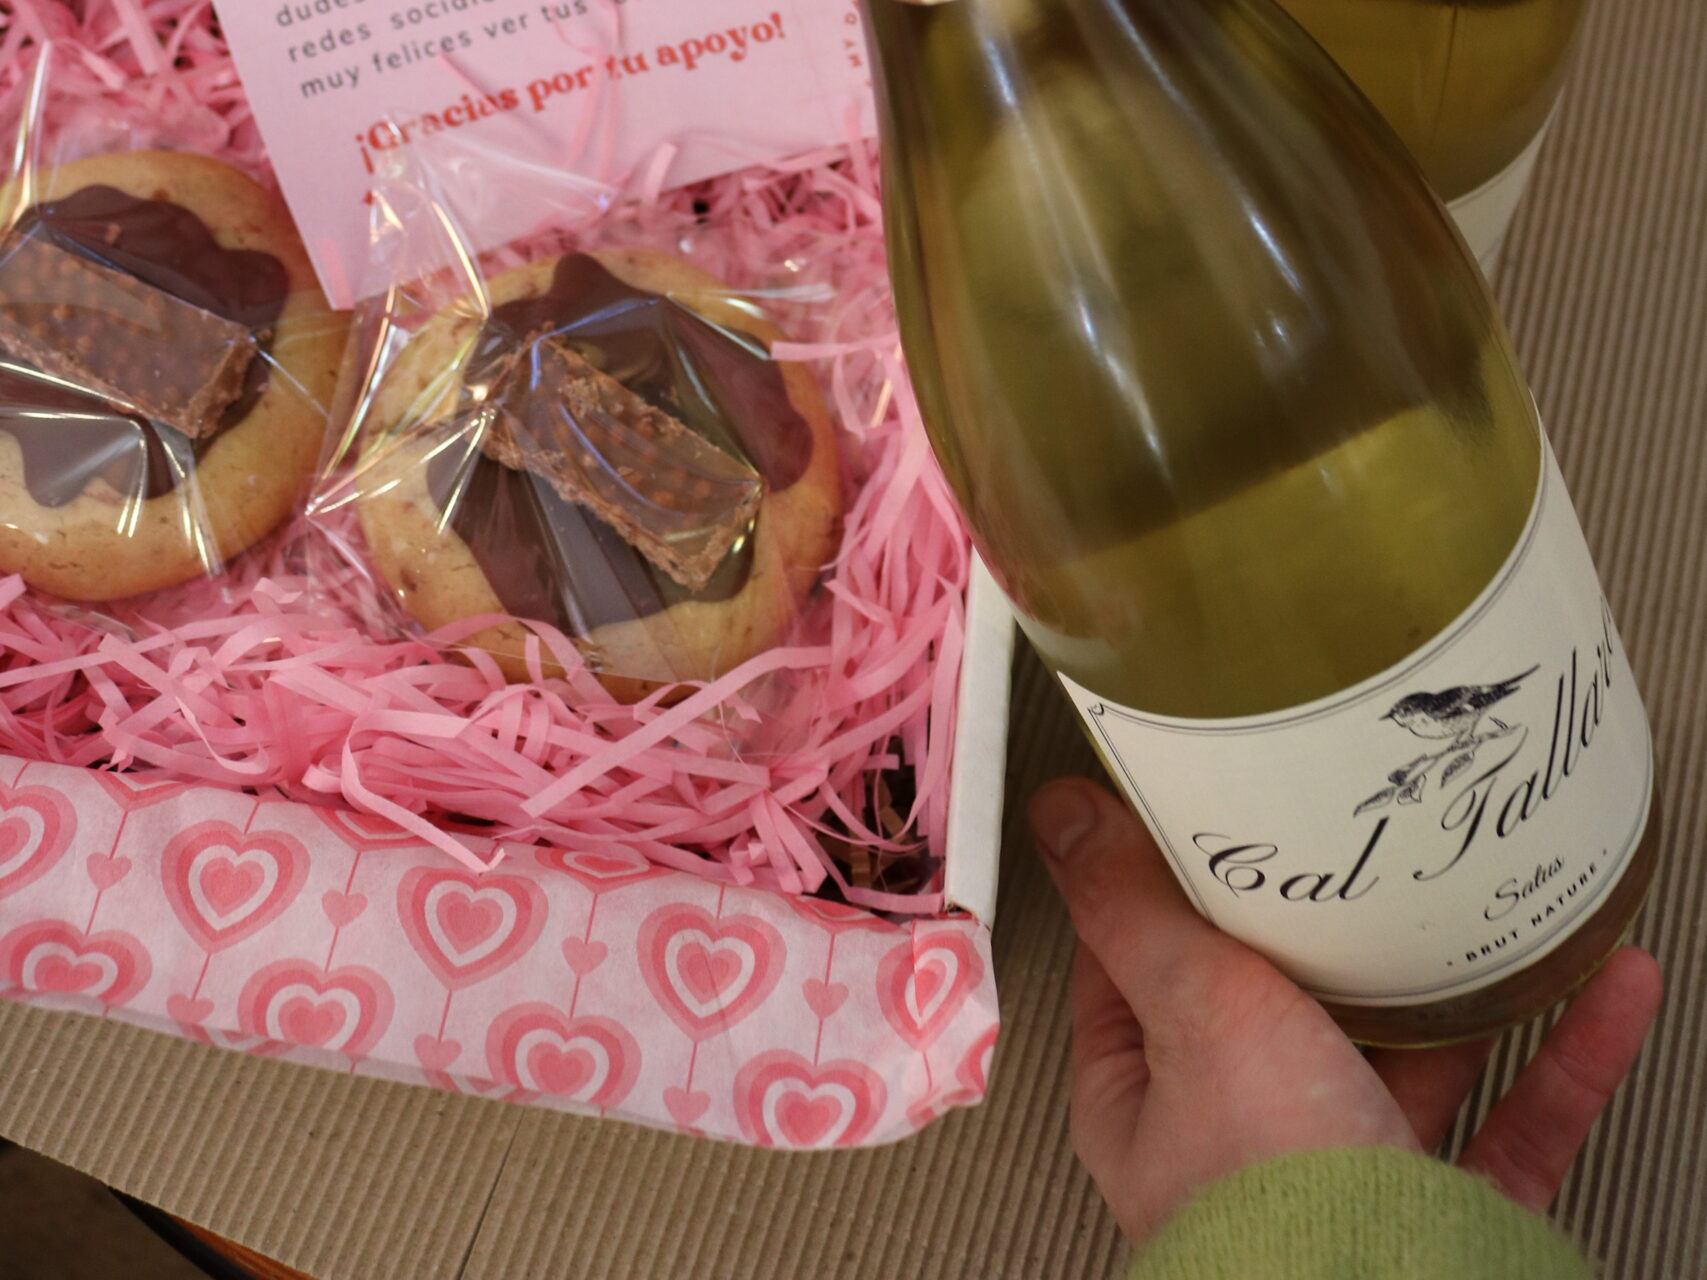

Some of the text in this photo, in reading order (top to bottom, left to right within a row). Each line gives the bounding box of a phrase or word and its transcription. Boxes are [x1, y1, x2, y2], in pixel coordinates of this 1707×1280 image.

[288, 24, 372, 62] redes
[300, 66, 359, 98] muy
[372, 31, 472, 73] felices
[483, 14, 527, 39] ver
[525, 65, 595, 114] por
[603, 52, 650, 81] tu
[655, 11, 786, 72] apoyo!
[1192, 816, 1390, 902] Cal
[1465, 862, 1597, 962] BRUT NATURE
